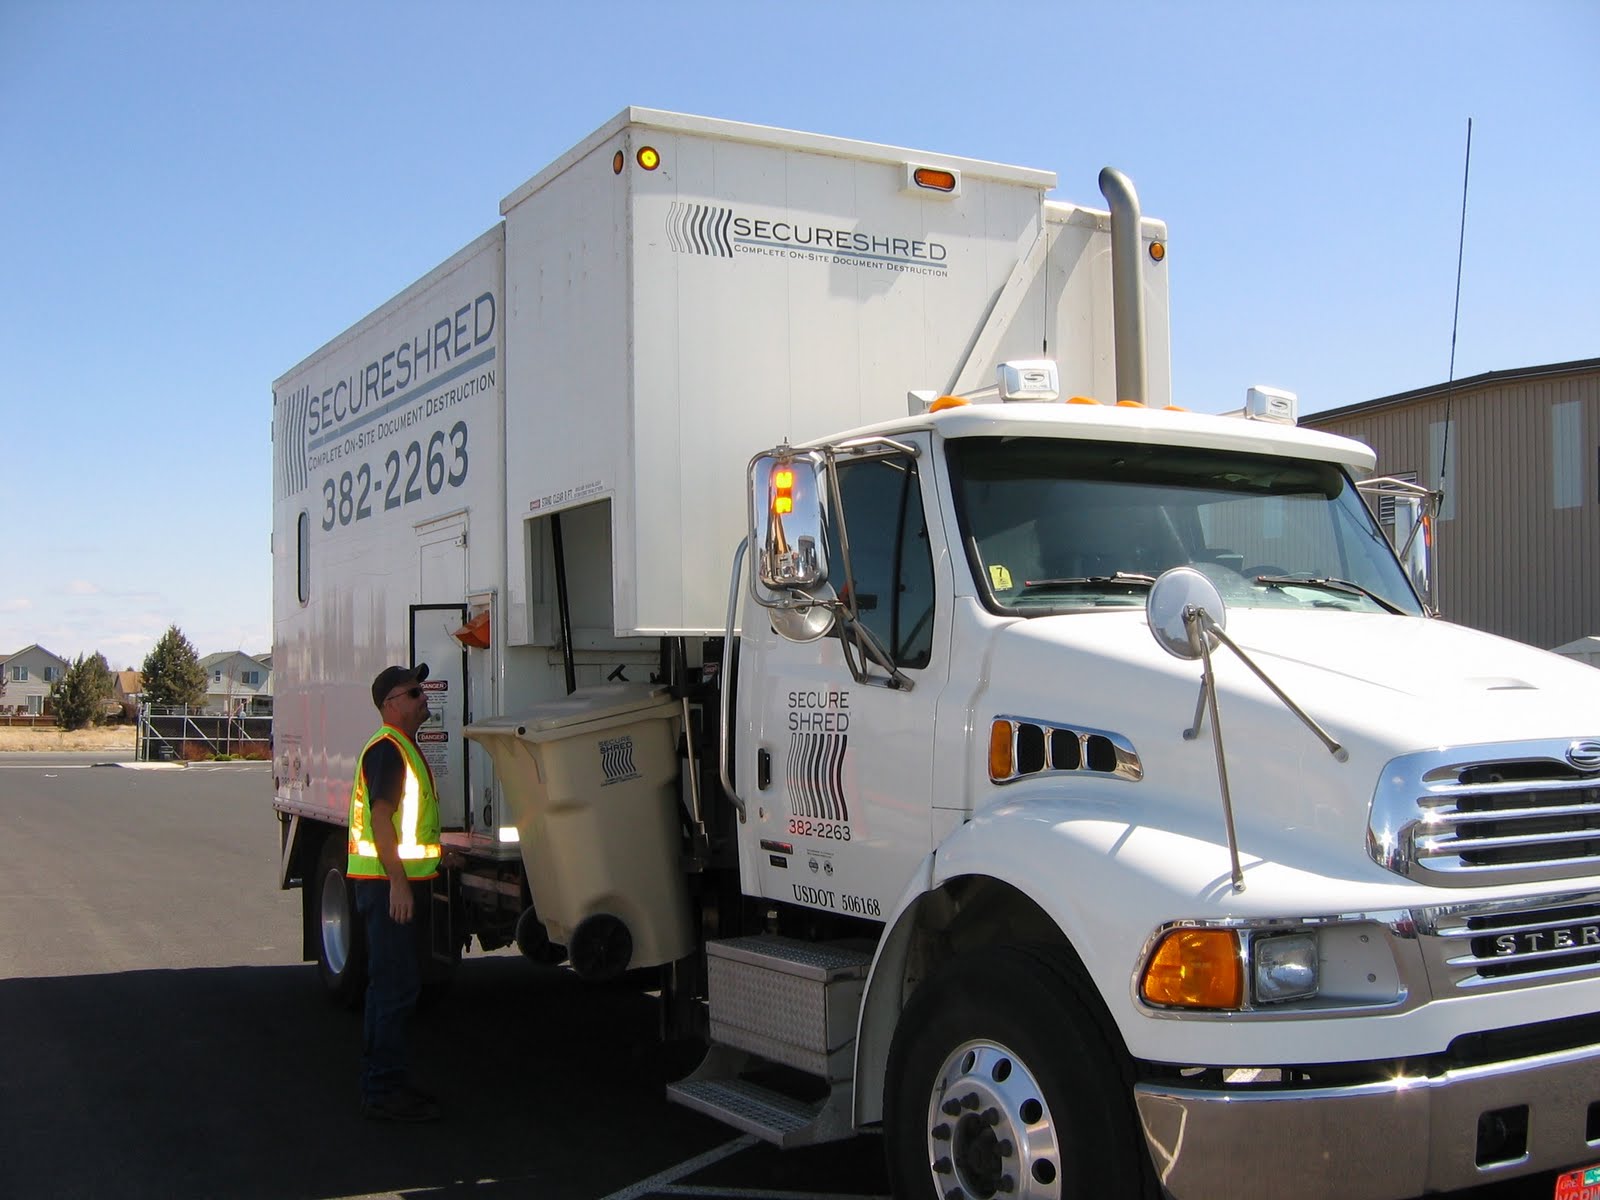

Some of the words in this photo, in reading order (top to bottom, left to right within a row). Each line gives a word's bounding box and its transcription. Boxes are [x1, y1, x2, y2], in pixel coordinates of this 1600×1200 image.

[733, 217, 947, 261] SECURESHRED
[734, 244, 786, 258] COMPLETE
[789, 251, 830, 264] ON-SITE
[832, 256, 884, 270] DOCUMENT
[886, 262, 948, 277] DESTRUCTION
[308, 291, 496, 436] SECURESHRED
[308, 444, 343, 471] COMPLETE
[344, 430, 376, 455] ON-SITE
[378, 406, 423, 440] DOCUMENT
[426, 370, 496, 418] DESTRUCTION
[322, 420, 469, 532] 382-2263
[995, 567, 1003, 578] 7
[788, 691, 849, 709] SECURE
[788, 712, 850, 732] SHRED
[598, 736, 632, 747] SECURE
[600, 742, 633, 754] SHRED
[789, 819, 851, 842] 382-2263
[792, 884, 835, 908] USDOT
[842, 894, 881, 917] 506168
